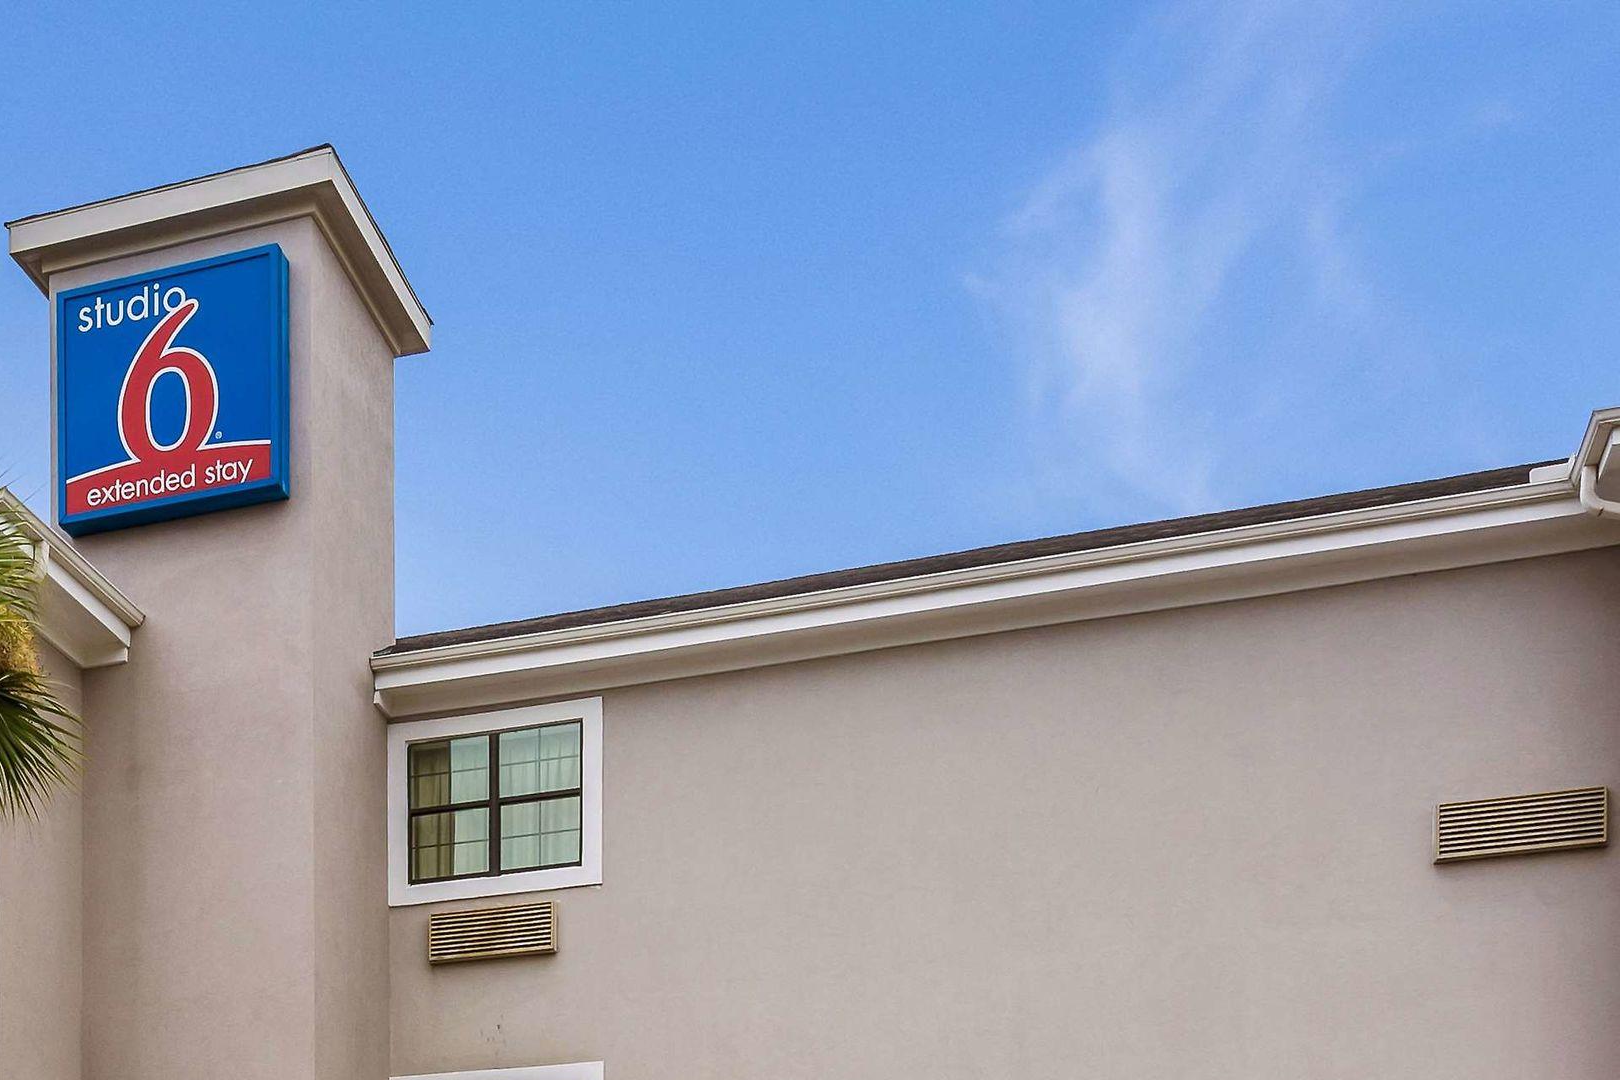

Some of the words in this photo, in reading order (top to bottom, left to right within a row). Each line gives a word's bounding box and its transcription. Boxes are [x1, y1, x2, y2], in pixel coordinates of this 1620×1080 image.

[78, 283, 186, 332] studio
[117, 298, 219, 463] 6
[86, 463, 196, 506] extended
[204, 458, 253, 484] stay
